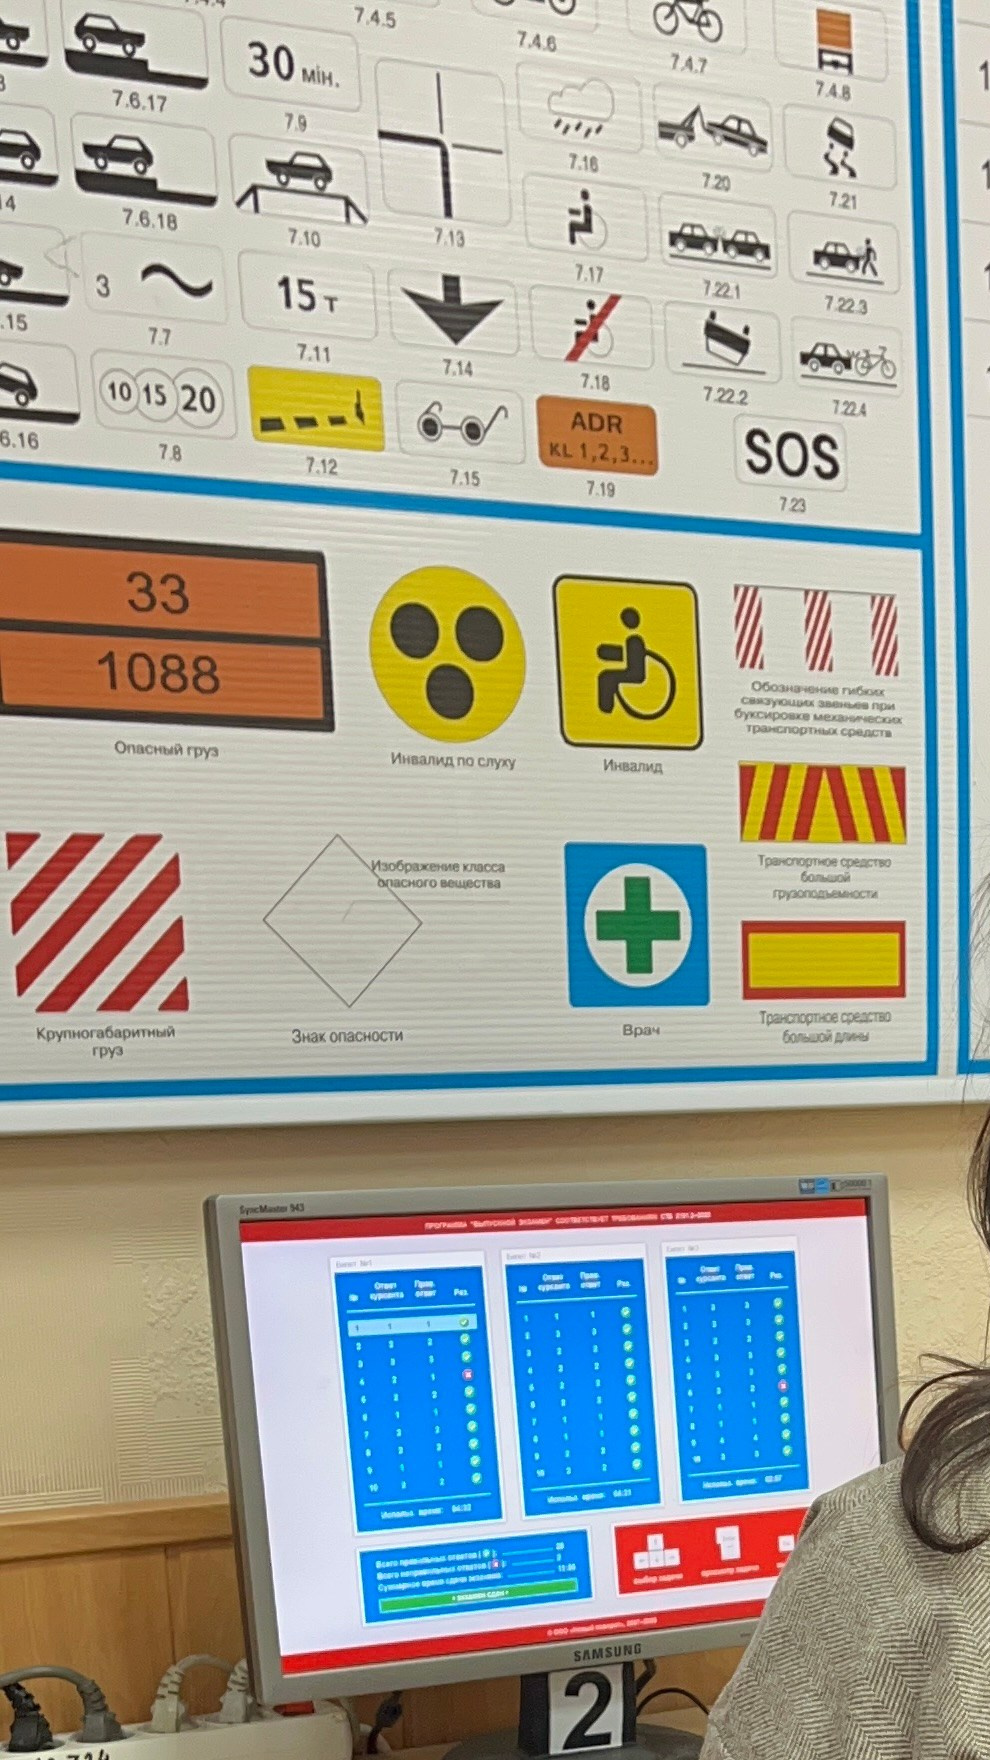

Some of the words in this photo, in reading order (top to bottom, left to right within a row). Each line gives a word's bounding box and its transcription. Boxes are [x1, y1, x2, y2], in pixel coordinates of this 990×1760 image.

[355, 7, 396, 28] 7.4.5
[518, 31, 556, 52] 7.4.6
[248, 41, 294, 81] 30
[671, 53, 707, 73] 7.4.7
[112, 89, 167, 112] 7.6.17
[285, 113, 307, 132] 7.9
[569, 153, 598, 173] 7.16
[702, 172, 730, 192] 7.20
[830, 191, 856, 209] 7.21
[123, 208, 177, 231] 7.6.18
[289, 228, 321, 247] 7.10
[576, 264, 603, 283] 7.17
[278, 276, 315, 311] 15
[704, 279, 740, 299] 7.22.1
[149, 327, 171, 346] 7.7
[298, 343, 330, 363] 7.11
[443, 359, 473, 377] 7.14
[581, 373, 610, 391] 7.18
[107, 381, 131, 401] 10
[143, 383, 166, 406] 15
[181, 384, 215, 413] 20
[704, 386, 748, 406] 7.22.2
[833, 400, 866, 417] 7.22.4
[571, 410, 623, 434] ADR
[159, 443, 182, 462] 7.8
[746, 428, 839, 480] SOS
[307, 457, 337, 476] 7.12
[451, 469, 480, 487] 7.15
[587, 480, 615, 497] 7.19
[780, 496, 806, 513] 7.23
[126, 571, 189, 614] 33
[97, 651, 220, 694] 1088
[751, 681, 839, 695] Обозначение
[842, 686, 885, 696] гибких
[741, 696, 814, 708] связующих
[818, 700, 869, 710] звеньев
[872, 703, 895, 712] при
[734, 709, 810, 721] буксировке
[813, 713, 902, 724] механических
[746, 724, 837, 737] транспортных
[840, 728, 892, 738] средств
[115, 740, 183, 755] Опасный
[187, 746, 219, 760] груз
[391, 752, 454, 768] Инвалид
[457, 757, 474, 767] по
[478, 757, 516, 770] слуху
[604, 759, 663, 775] Инвалид
[371, 860, 460, 875] Изображение
[462, 862, 505, 873] класса
[758, 855, 838, 868] Транспортное
[840, 857, 891, 868] средство
[377, 878, 437, 890] опасного
[440, 879, 501, 889] вещества
[801, 871, 850, 882] большой
[773, 889, 878, 901] грузоподъемности
[760, 1011, 838, 1024] Транспортное
[841, 1012, 891, 1025] средство
[37, 1026, 175, 1042] Крупногабаритный
[292, 1029, 326, 1044] Знак
[330, 1031, 403, 1043] опасности
[623, 1024, 660, 1038] Врач
[782, 1029, 832, 1044] большой
[834, 1032, 869, 1044] длины
[93, 1046, 123, 1059] груз
[574, 1643, 642, 1662] SAMSUNG
[563, 1671, 613, 1751] 2
